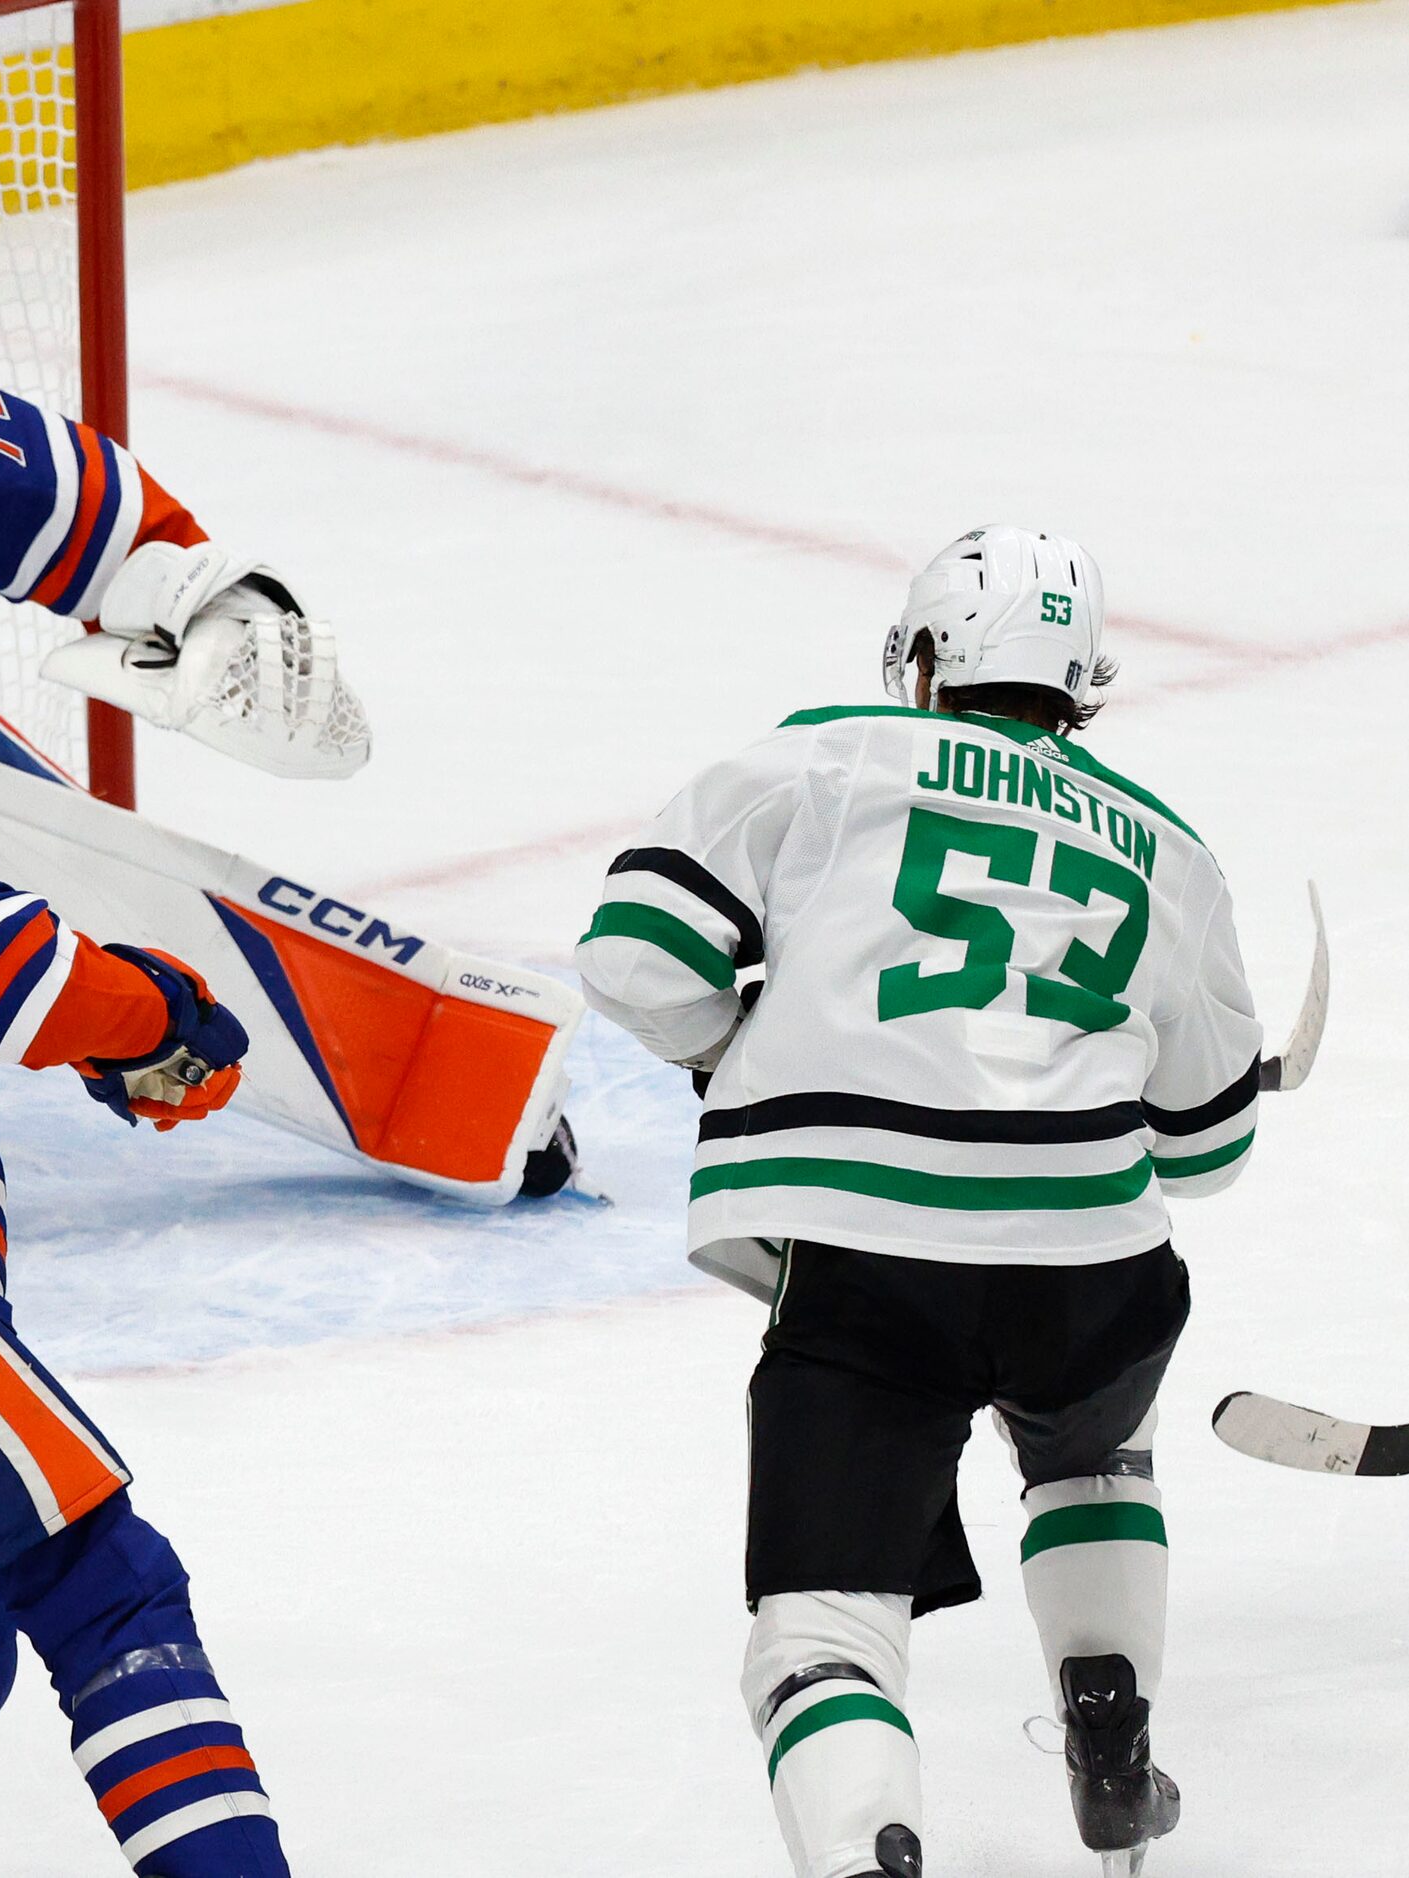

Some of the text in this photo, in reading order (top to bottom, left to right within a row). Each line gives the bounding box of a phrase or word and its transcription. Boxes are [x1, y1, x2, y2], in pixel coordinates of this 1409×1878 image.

[1041, 592, 1072, 626] 53
[917, 738, 1157, 881] JOHNSTON
[257, 876, 426, 966] CCM
[878, 807, 1150, 1034] 53
